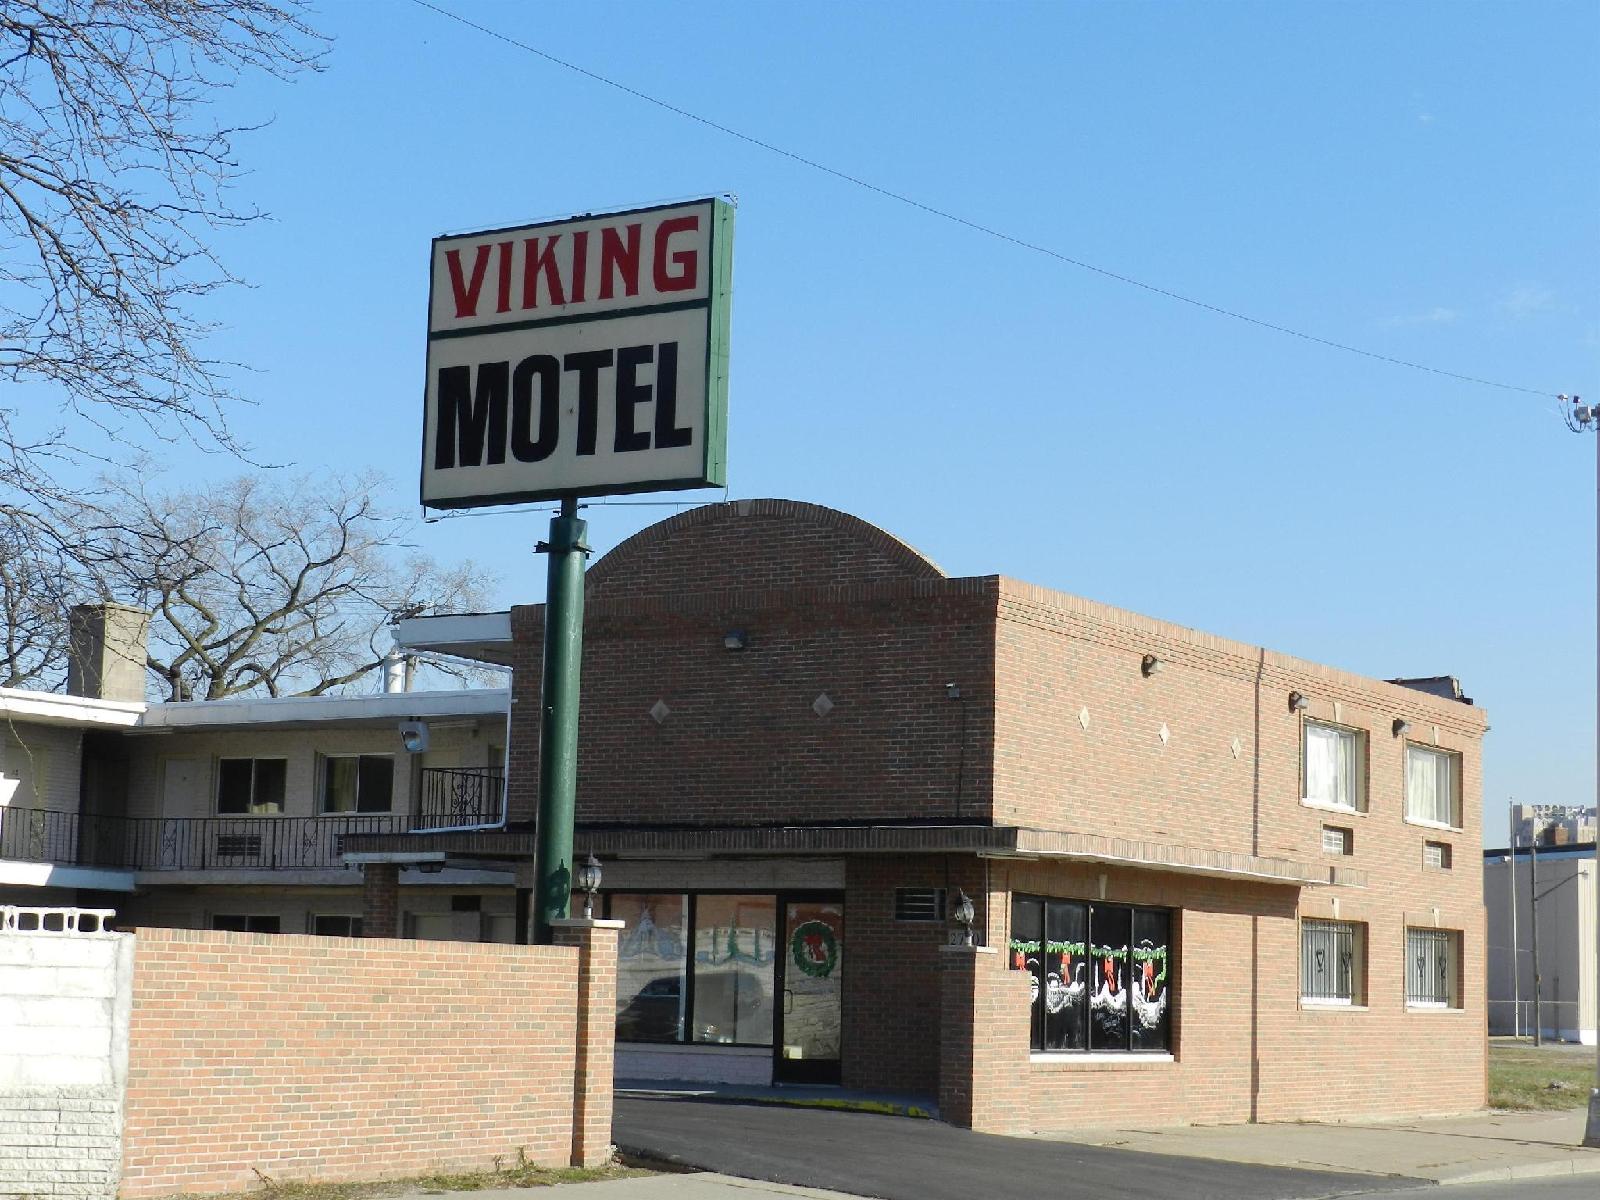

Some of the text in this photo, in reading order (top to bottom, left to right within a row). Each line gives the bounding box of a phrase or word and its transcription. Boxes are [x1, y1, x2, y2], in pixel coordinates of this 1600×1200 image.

[445, 216, 698, 318] VIKING
[434, 342, 692, 469] MOTEL
[951, 932, 979, 945] 270
